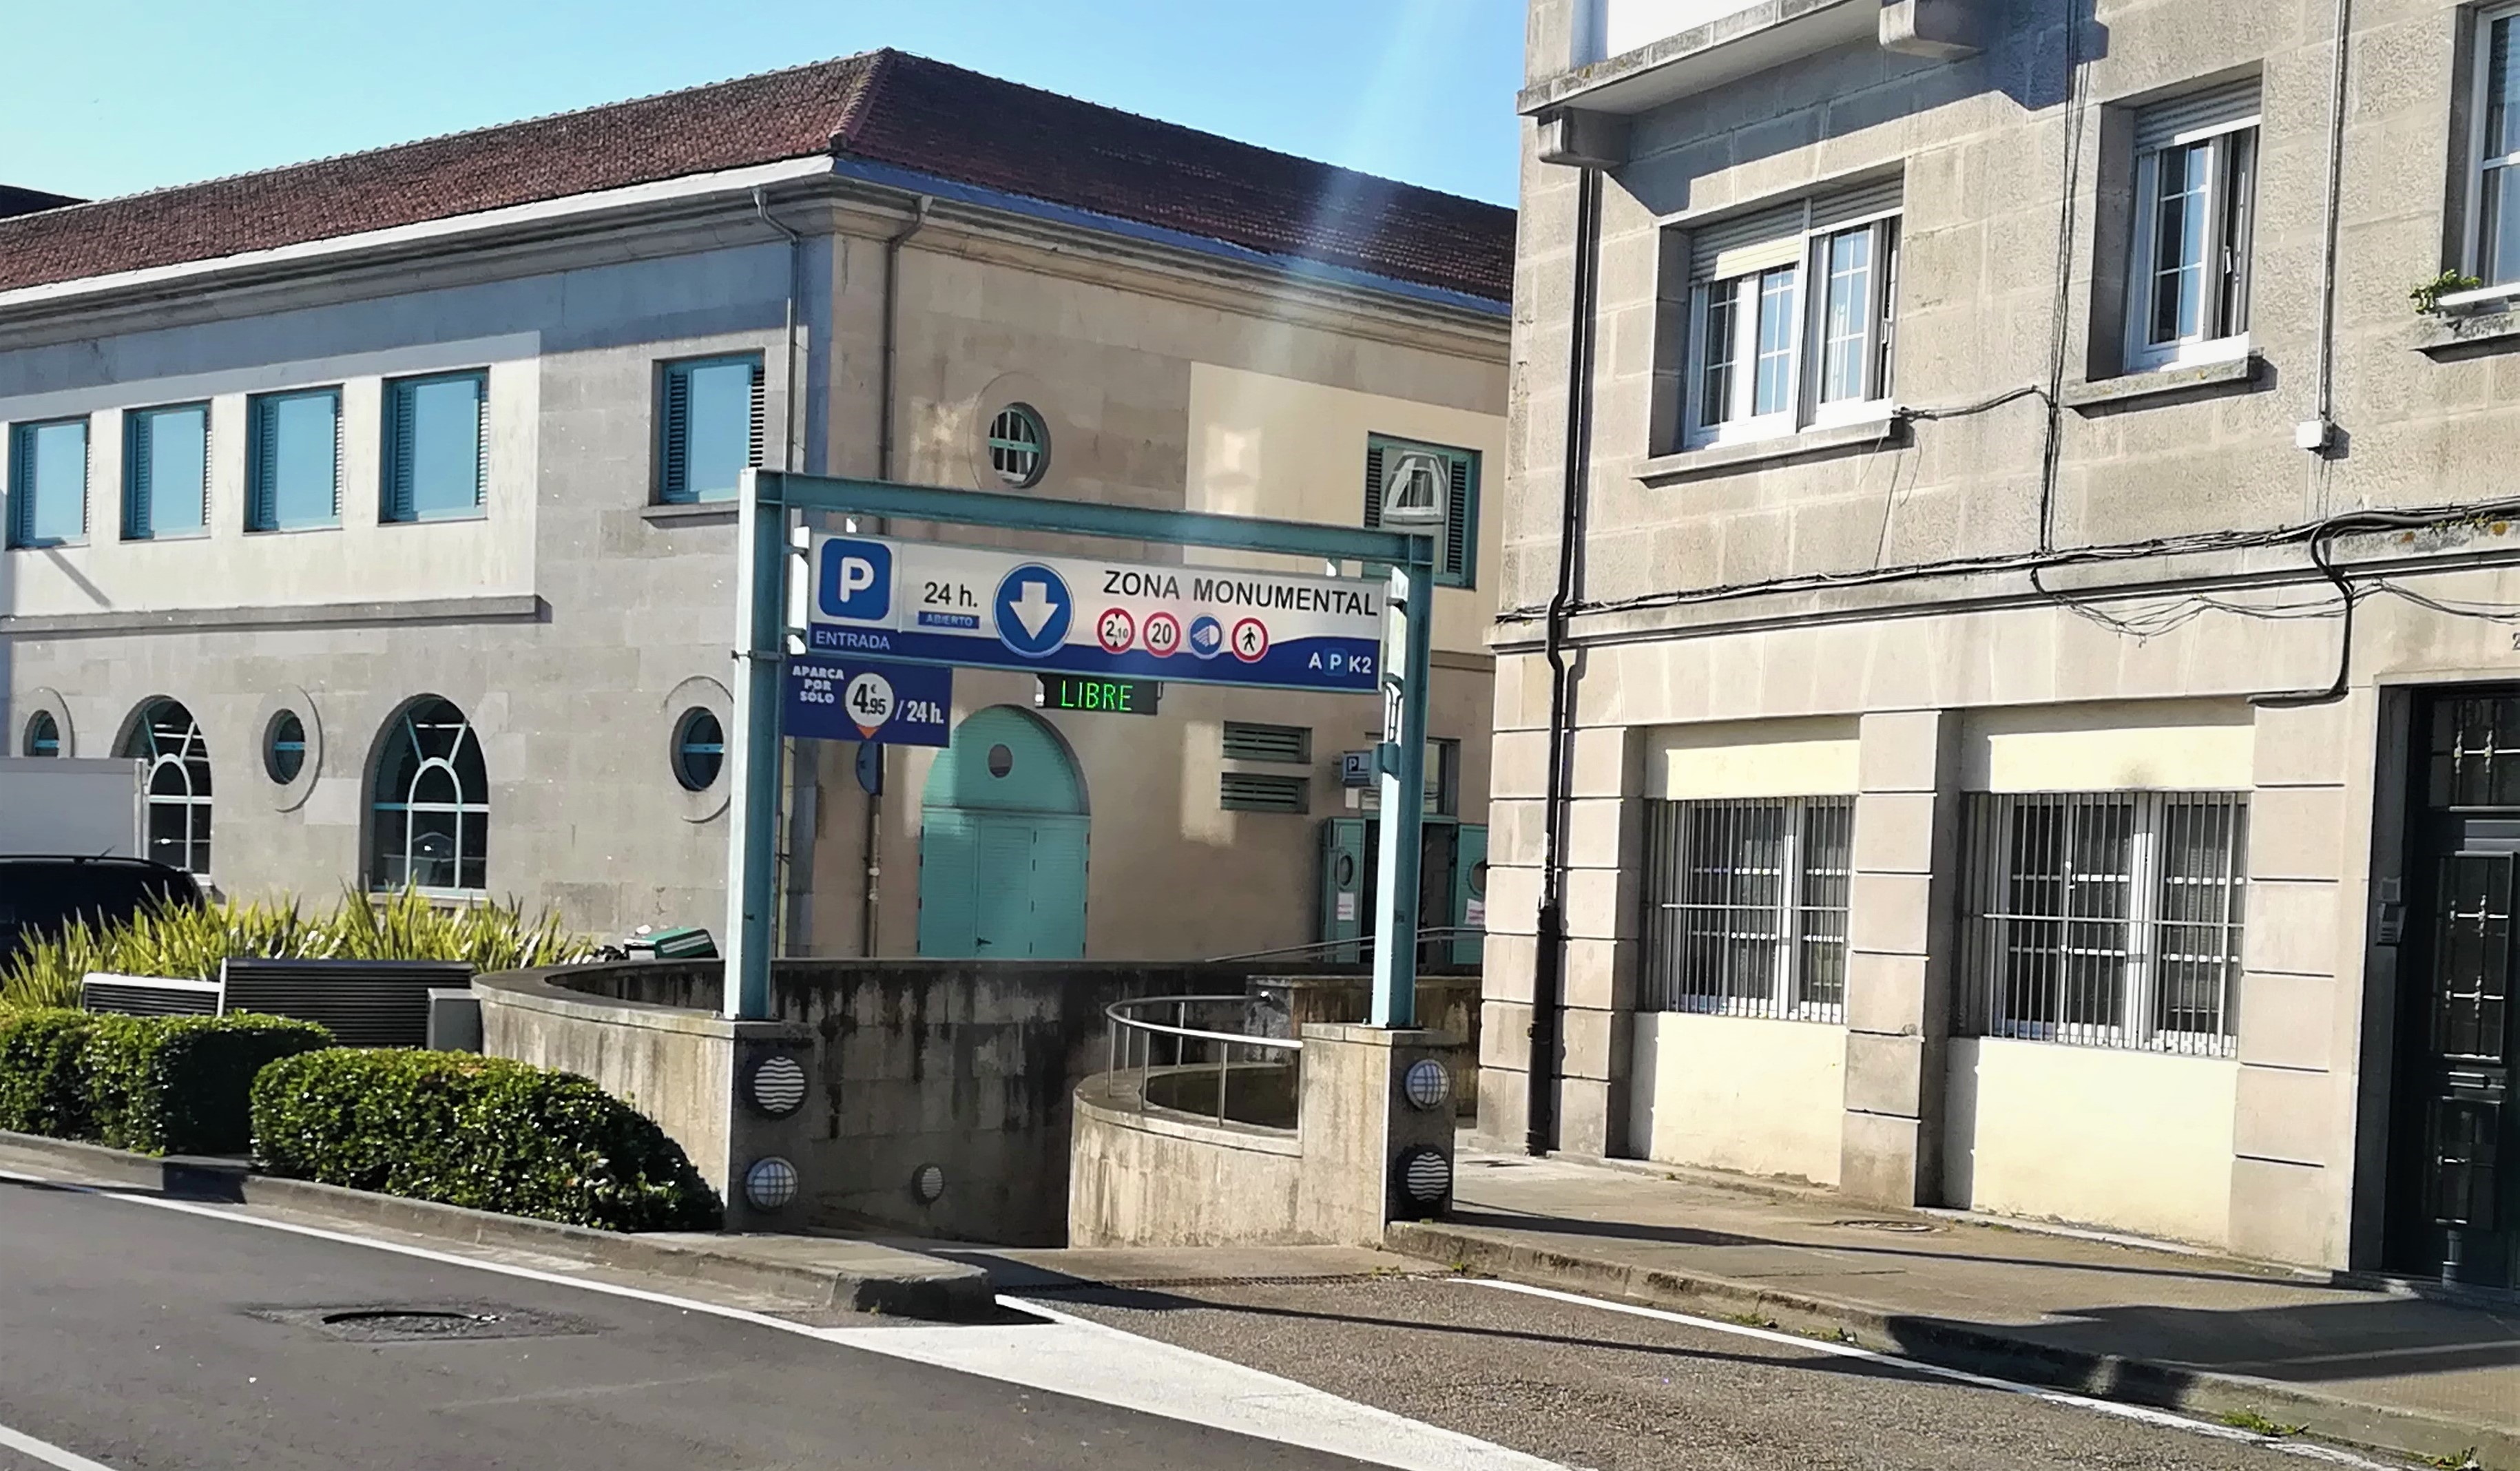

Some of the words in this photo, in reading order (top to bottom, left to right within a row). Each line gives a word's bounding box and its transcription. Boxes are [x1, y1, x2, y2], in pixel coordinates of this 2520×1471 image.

[840, 556, 874, 603] P
[924, 582, 951, 605] 24
[959, 584, 978, 607] h.
[1103, 570, 1180, 600] ZONA
[1194, 578, 1377, 616] MONUMENTAL
[925, 614, 973, 627] ABIERTO
[815, 630, 891, 649] ENTRADA
[1152, 623, 1172, 644] 20
[792, 665, 844, 680] APARCA
[804, 678, 832, 691] POR
[1061, 680, 1134, 711] LIBRE
[1348, 758, 1357, 771] P
